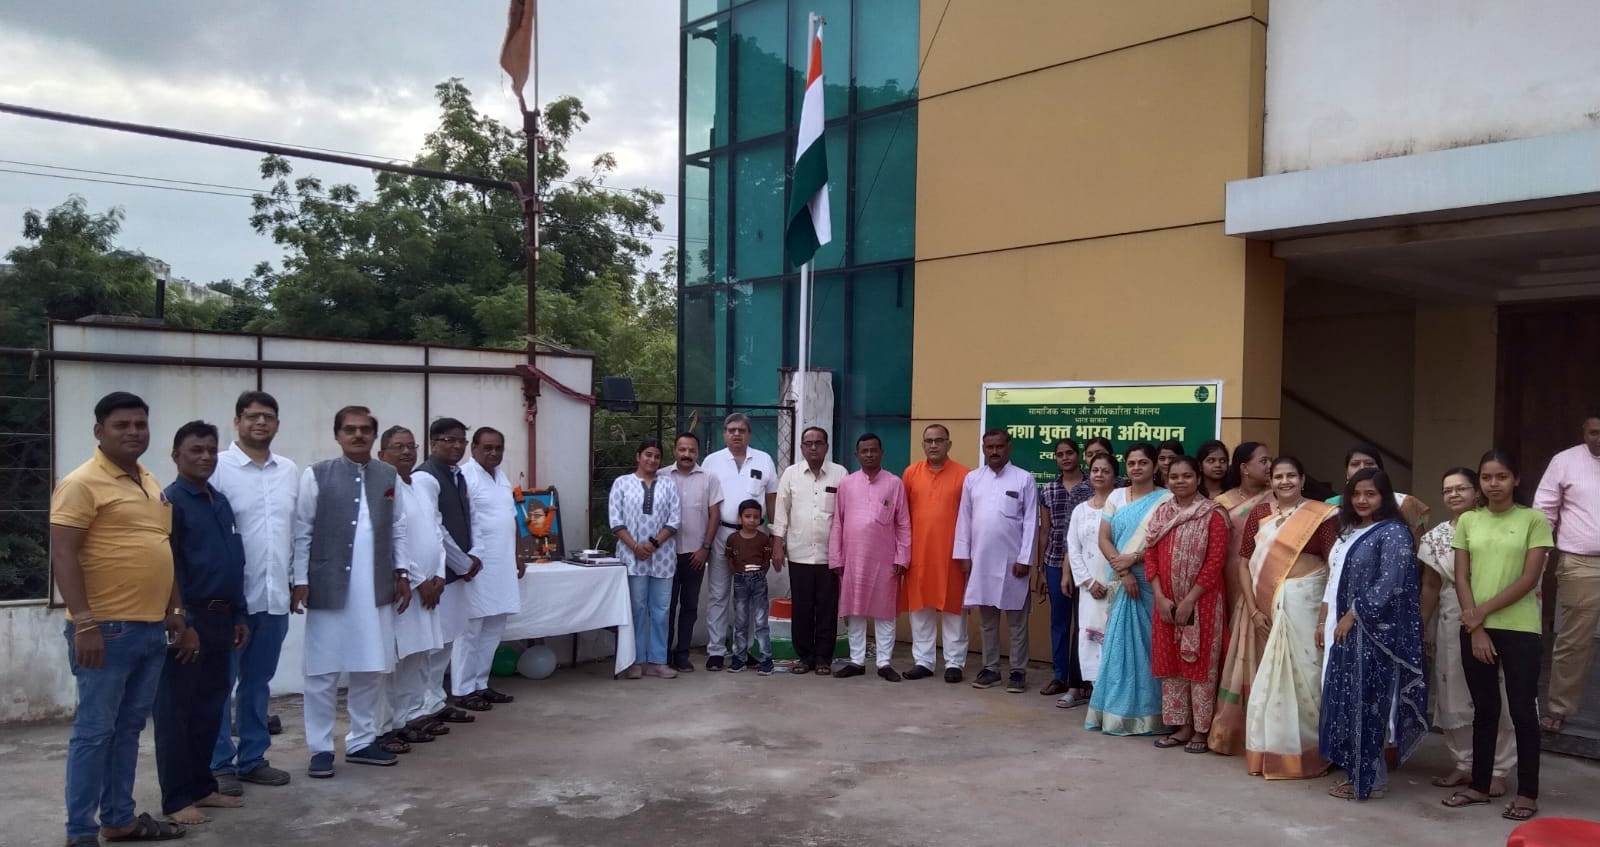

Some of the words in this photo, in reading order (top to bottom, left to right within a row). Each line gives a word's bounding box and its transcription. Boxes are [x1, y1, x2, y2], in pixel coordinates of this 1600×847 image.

[1028, 406, 1059, 415] सामाजिक
[1061, 407, 1076, 415] न्याय
[1079, 406, 1092, 415] और
[1093, 405, 1131, 415] अधिकारिता
[1133, 406, 1160, 415] मंत्रालय
[1007, 424, 1036, 439] नशा
[1039, 425, 1072, 444] मुक्त
[1075, 425, 1113, 440] भारत
[1118, 421, 1186, 441] अभियान
